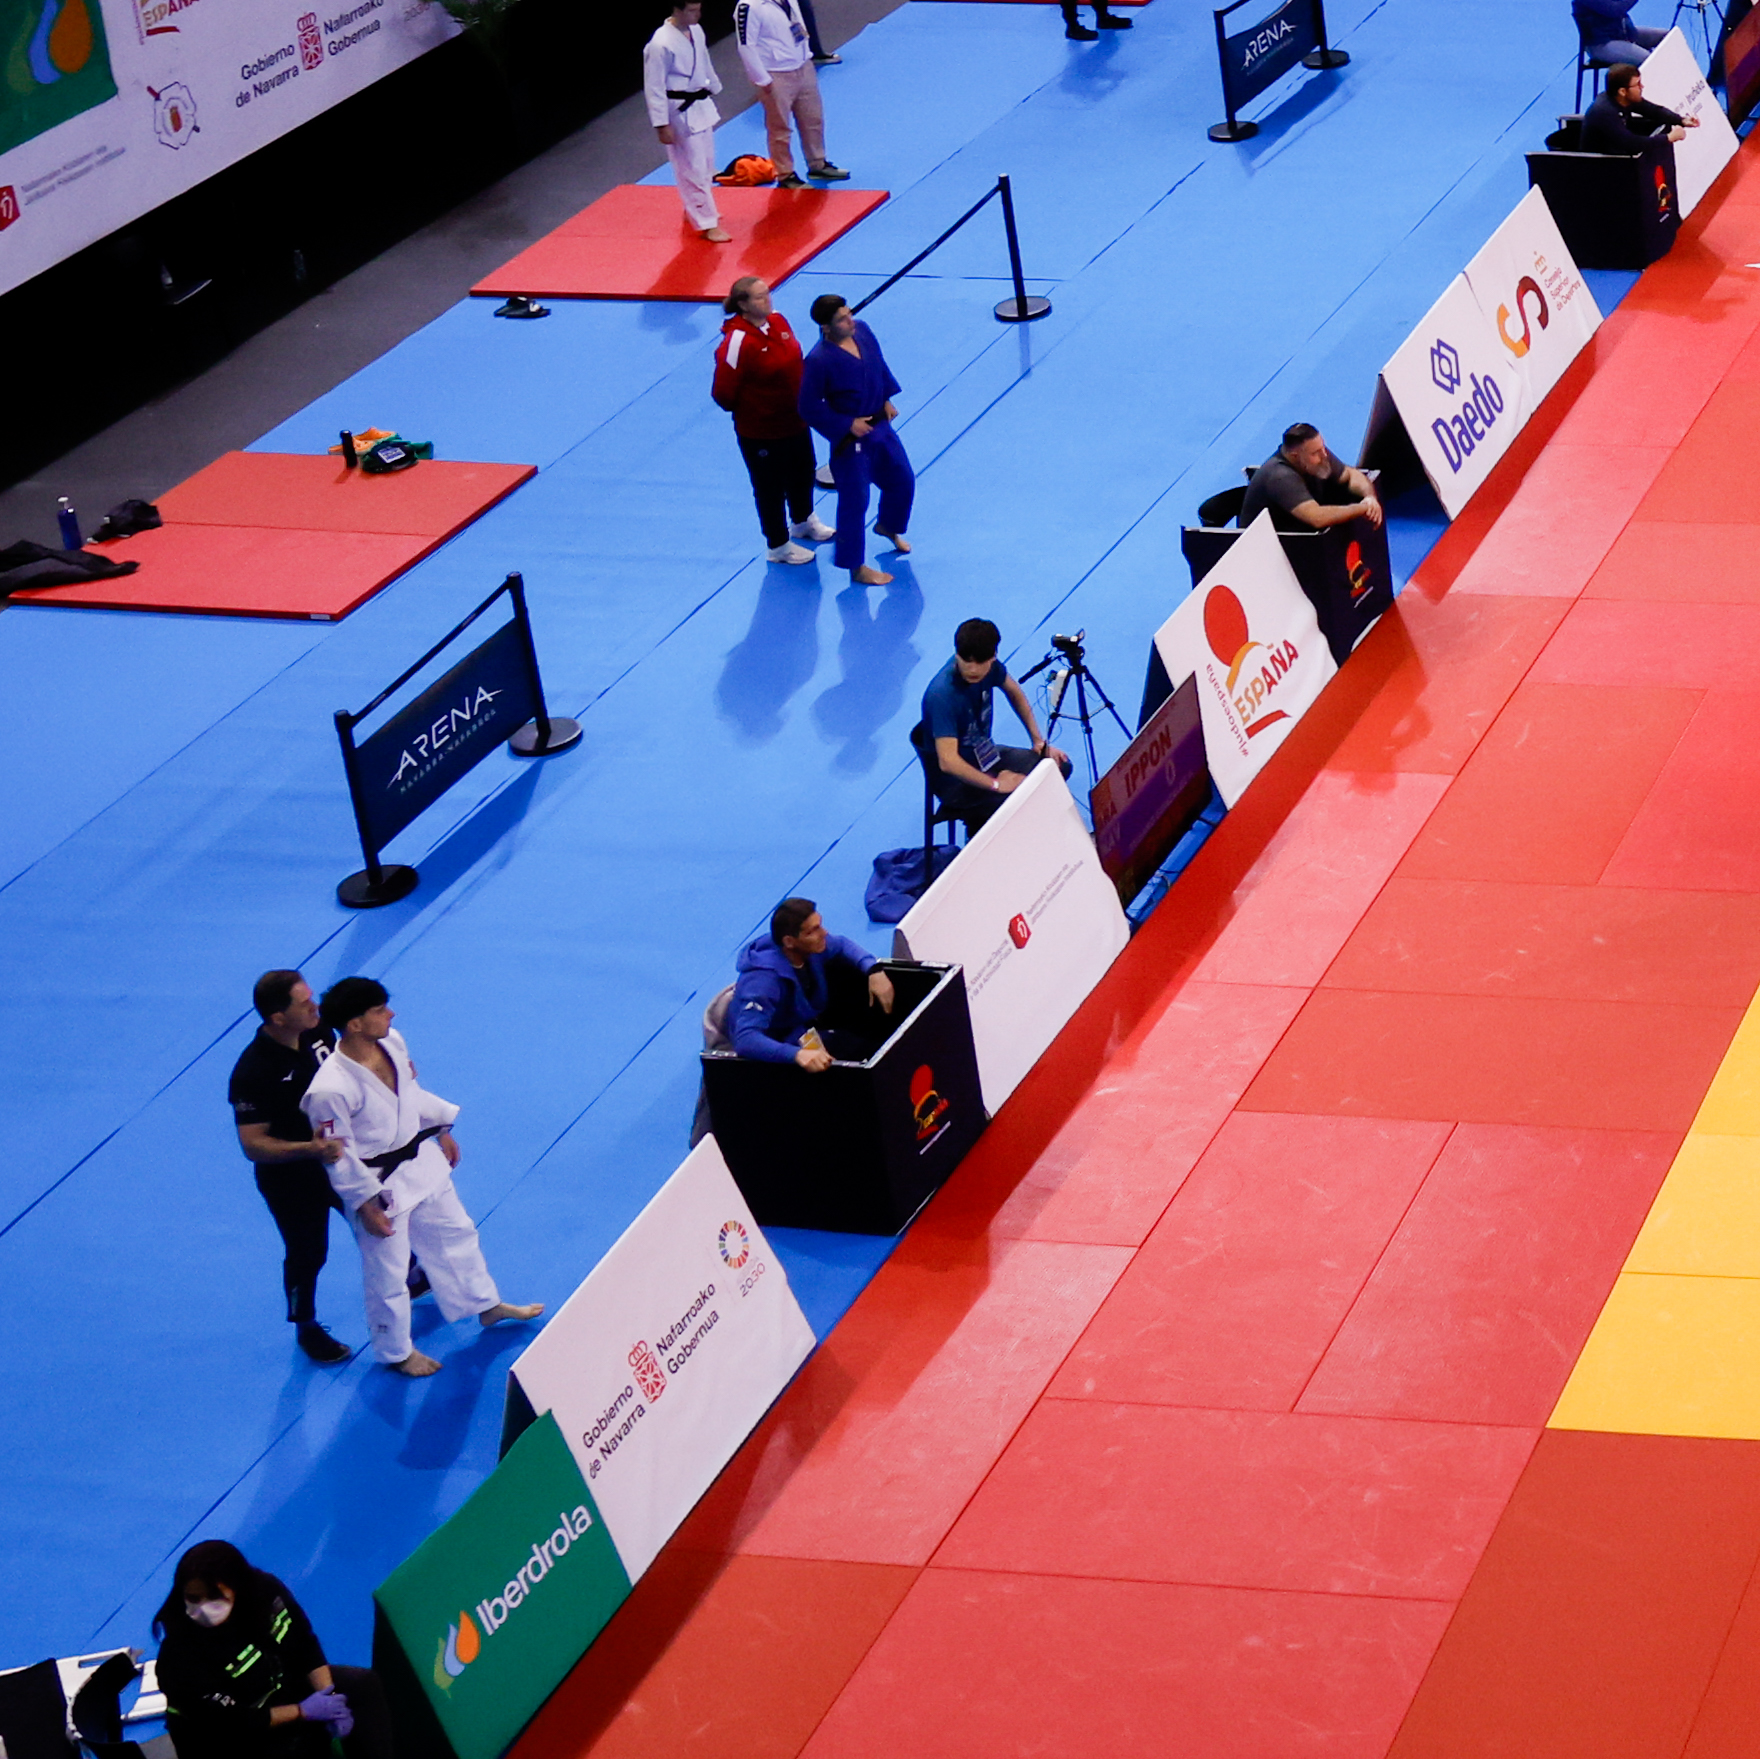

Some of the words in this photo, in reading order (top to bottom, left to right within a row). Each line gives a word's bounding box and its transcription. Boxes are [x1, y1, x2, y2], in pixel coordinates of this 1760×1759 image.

[240, 42, 295, 82] Gobierno
[328, 18, 381, 58] Gobernua
[1241, 18, 1297, 70] ARENA
[235, 88, 252, 109] de
[252, 64, 300, 100] Navarra
[1430, 371, 1504, 475] Daedo
[1205, 663, 1250, 758] #judoespaña
[1232, 638, 1300, 727] ESPAÑA
[386, 685, 504, 790] ARENA
[1123, 725, 1173, 798] IPPON
[739, 1262, 766, 1298] 2030
[655, 1282, 717, 1357] Nafarroako
[666, 1309, 720, 1375] Gobernua
[582, 1384, 635, 1450] Gobierno
[588, 1457, 602, 1481] de
[599, 1403, 647, 1462] Navarra
[474, 1503, 594, 1637] Iberdrola
